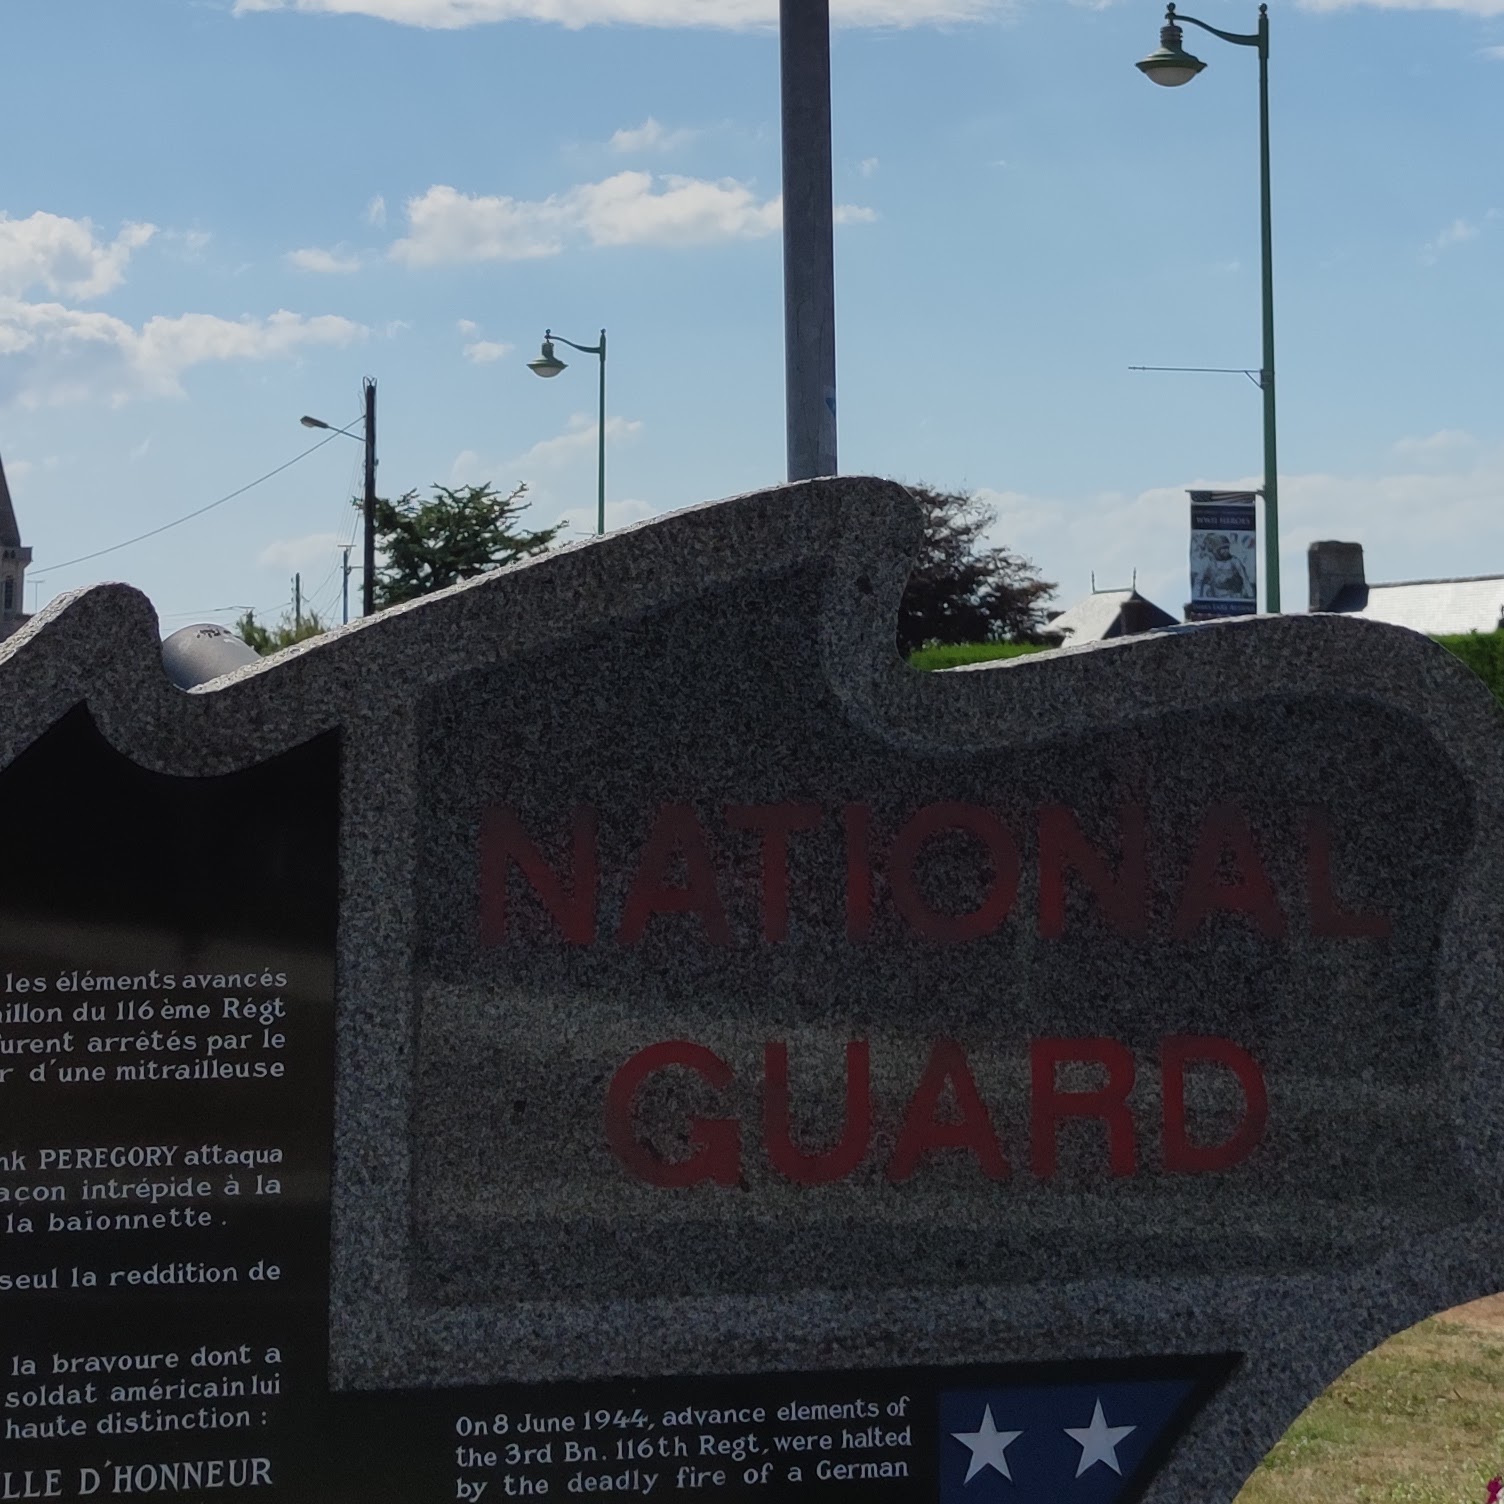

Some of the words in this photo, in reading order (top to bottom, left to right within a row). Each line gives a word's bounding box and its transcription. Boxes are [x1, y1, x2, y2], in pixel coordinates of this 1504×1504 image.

[478, 802, 1391, 947] NATIONAL
[4, 972, 48, 994] les
[55, 968, 177, 993] éléments
[181, 966, 288, 990] avancés
[71, 1000, 107, 1023] du
[159, 997, 212, 1021] ème
[221, 996, 287, 1026] Régt
[86, 1029, 198, 1054] arrêtés
[205, 1033, 254, 1057] par
[261, 1027, 286, 1050] le
[115, 1057, 285, 1082] mitrailleuse
[604, 1033, 1269, 1191] GUARD
[38, 1145, 180, 1171] PEREGORY
[183, 1143, 284, 1170] attaqua
[81, 1175, 212, 1205] intrépide
[222, 1173, 242, 1197] à
[254, 1173, 282, 1196] la
[5, 1212, 35, 1234] la
[70, 1266, 98, 1288] la
[108, 1261, 239, 1287] reddition
[247, 1259, 281, 1282] de
[10, 1354, 37, 1377] la
[51, 1352, 180, 1375] bravoure
[189, 1343, 252, 1368] dont
[263, 1346, 283, 1365] a
[4, 1381, 98, 1409] soldat
[109, 1375, 246, 1403] américain
[250, 1372, 281, 1396] lui
[4, 1414, 88, 1440] haute
[455, 1415, 489, 1438] On
[491, 1413, 510, 1436] 8
[516, 1412, 576, 1434] June
[582, 1408, 656, 1432] 1944,
[661, 1405, 766, 1427] advance
[776, 1398, 880, 1422] elements
[885, 1395, 911, 1418] of
[454, 1445, 498, 1468] the
[504, 1441, 554, 1466] 3rd
[563, 1440, 608, 1463] Bn.
[615, 1435, 689, 1461] 116th
[698, 1432, 770, 1463] Regt,
[772, 1434, 833, 1452] were
[840, 1424, 913, 1450] halted
[455, 1476, 489, 1504] by
[502, 1473, 549, 1497] the
[566, 1468, 660, 1496] deadly
[675, 1465, 727, 1489] fire
[742, 1461, 775, 1485] of
[786, 1465, 803, 1483] a
[815, 1459, 909, 1481] German
